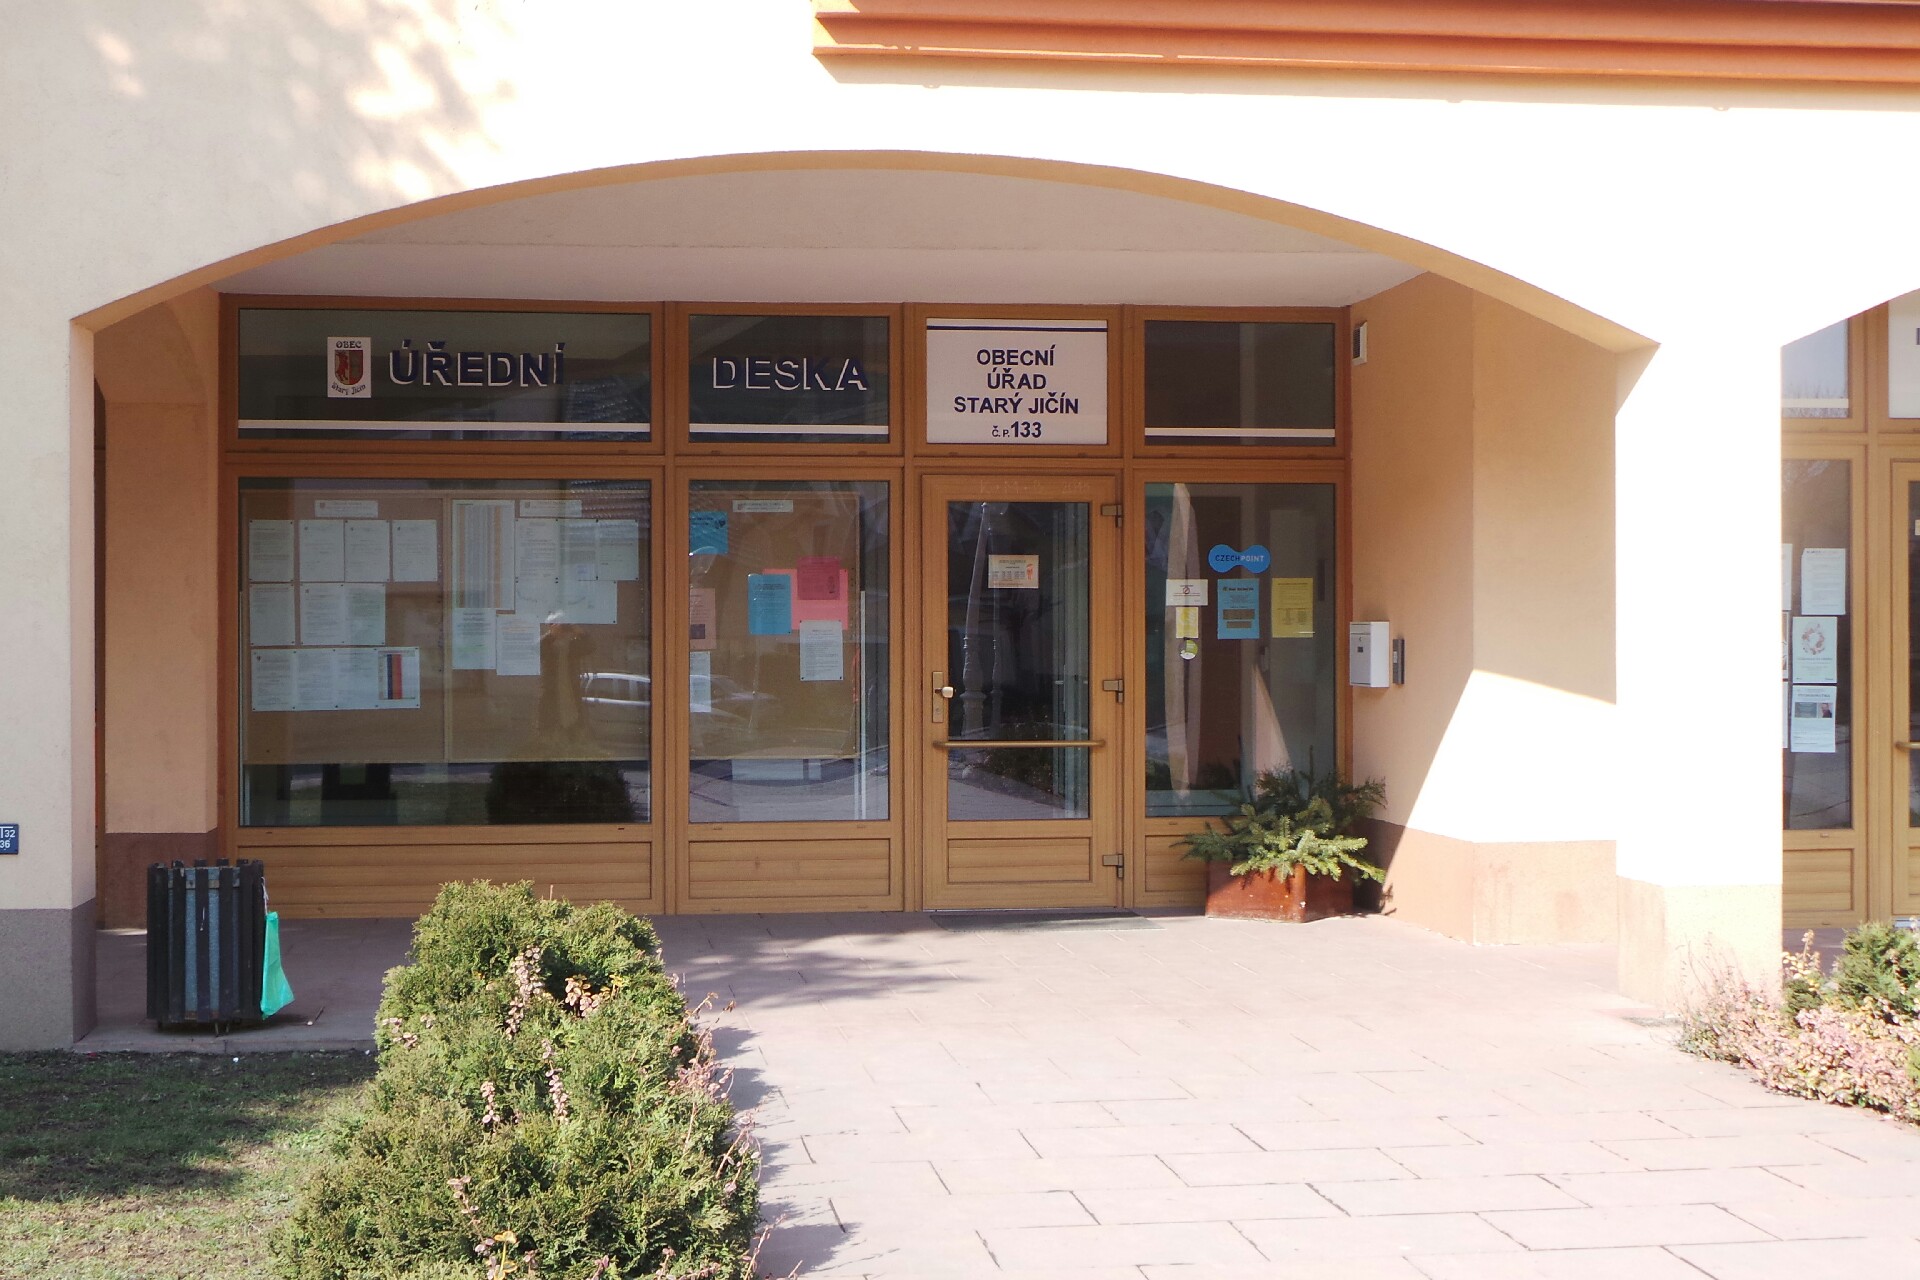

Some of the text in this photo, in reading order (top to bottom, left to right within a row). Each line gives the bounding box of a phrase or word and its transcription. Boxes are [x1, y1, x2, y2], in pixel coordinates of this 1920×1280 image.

[335, 340, 362, 348] OBEC
[976, 344, 1056, 366] OBECNÍ
[389, 338, 870, 391] ÚŘEDNÍ DESKA
[987, 367, 1047, 390] ÚŘAD
[953, 391, 1079, 414] STARÝ JIČÍN
[1010, 421, 1042, 438] 133
